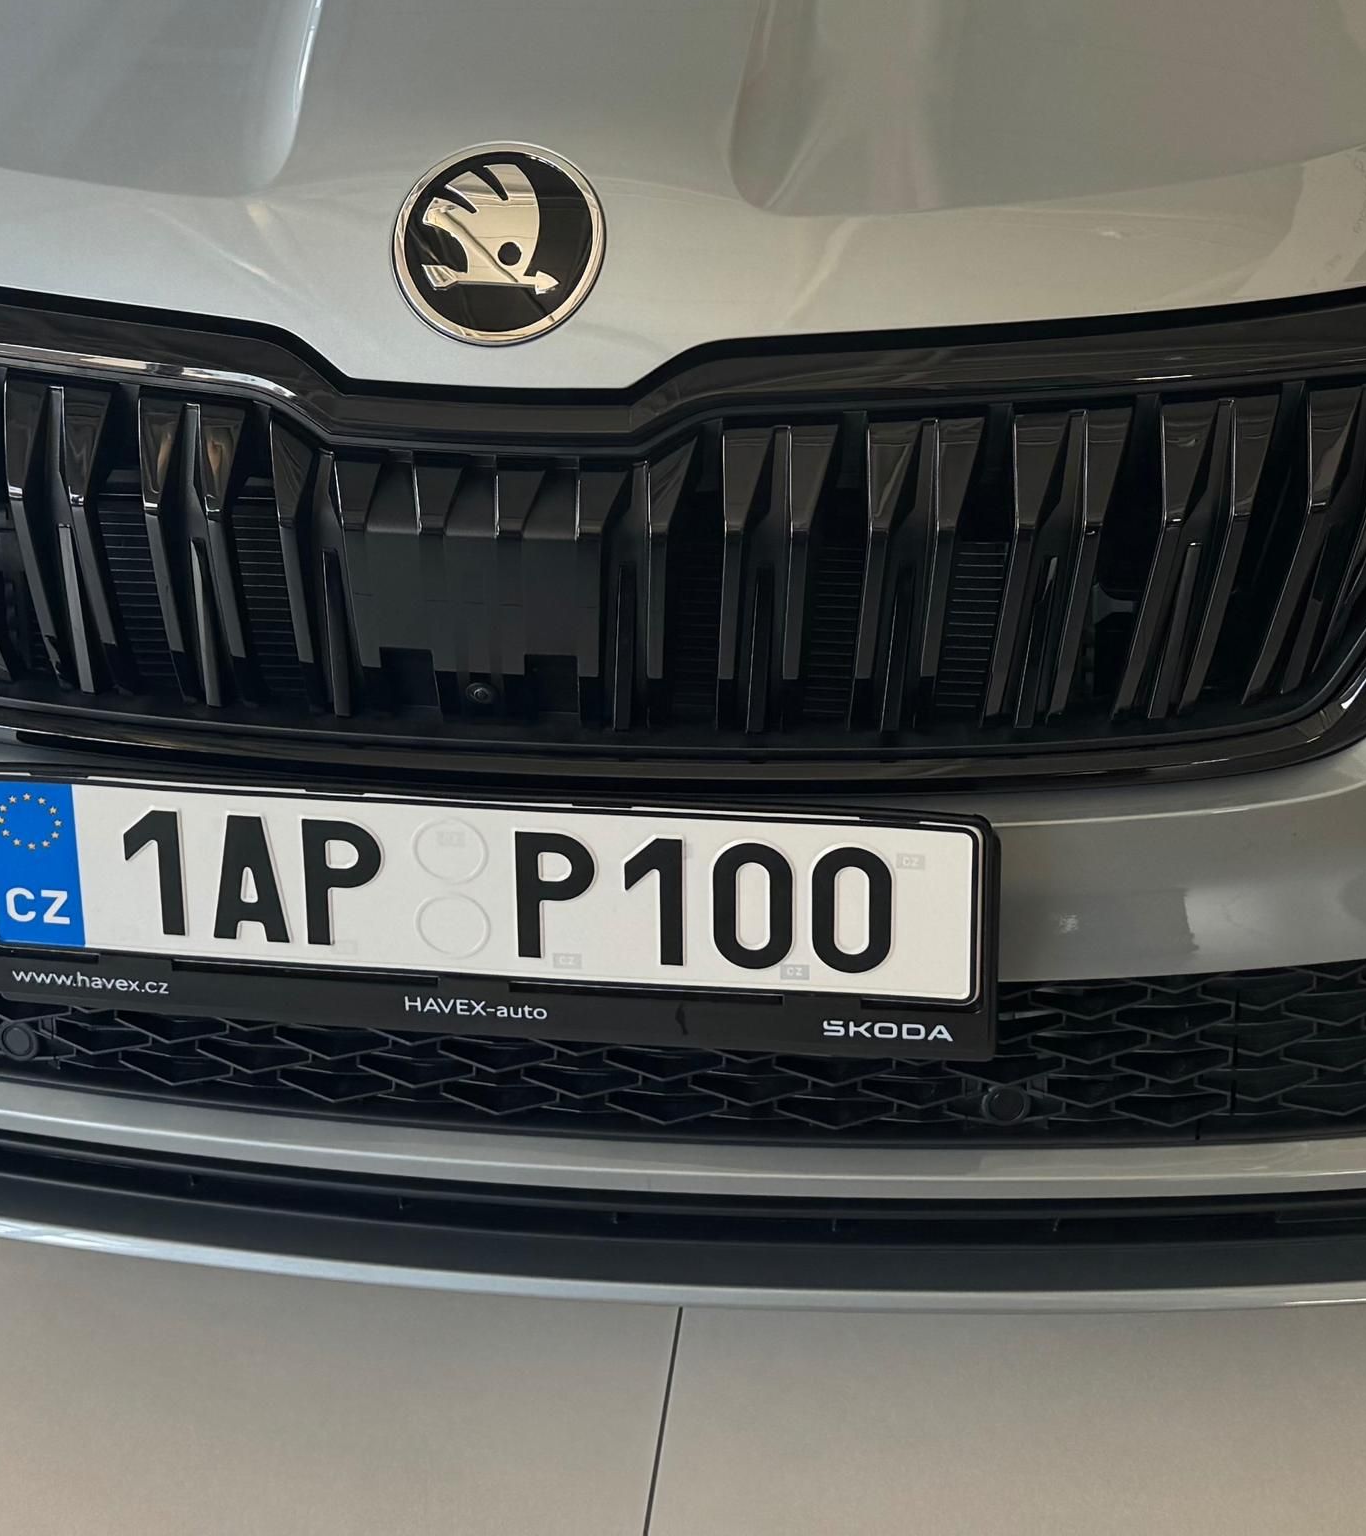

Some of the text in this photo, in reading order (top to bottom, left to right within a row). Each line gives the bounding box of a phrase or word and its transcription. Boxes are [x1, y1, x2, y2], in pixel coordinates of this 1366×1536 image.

[5, 886, 72, 926] CZ
[123, 809, 892, 974] 1AP P100
[11, 969, 170, 995] www.havex.cz
[403, 995, 548, 1021] HAVEX-auto
